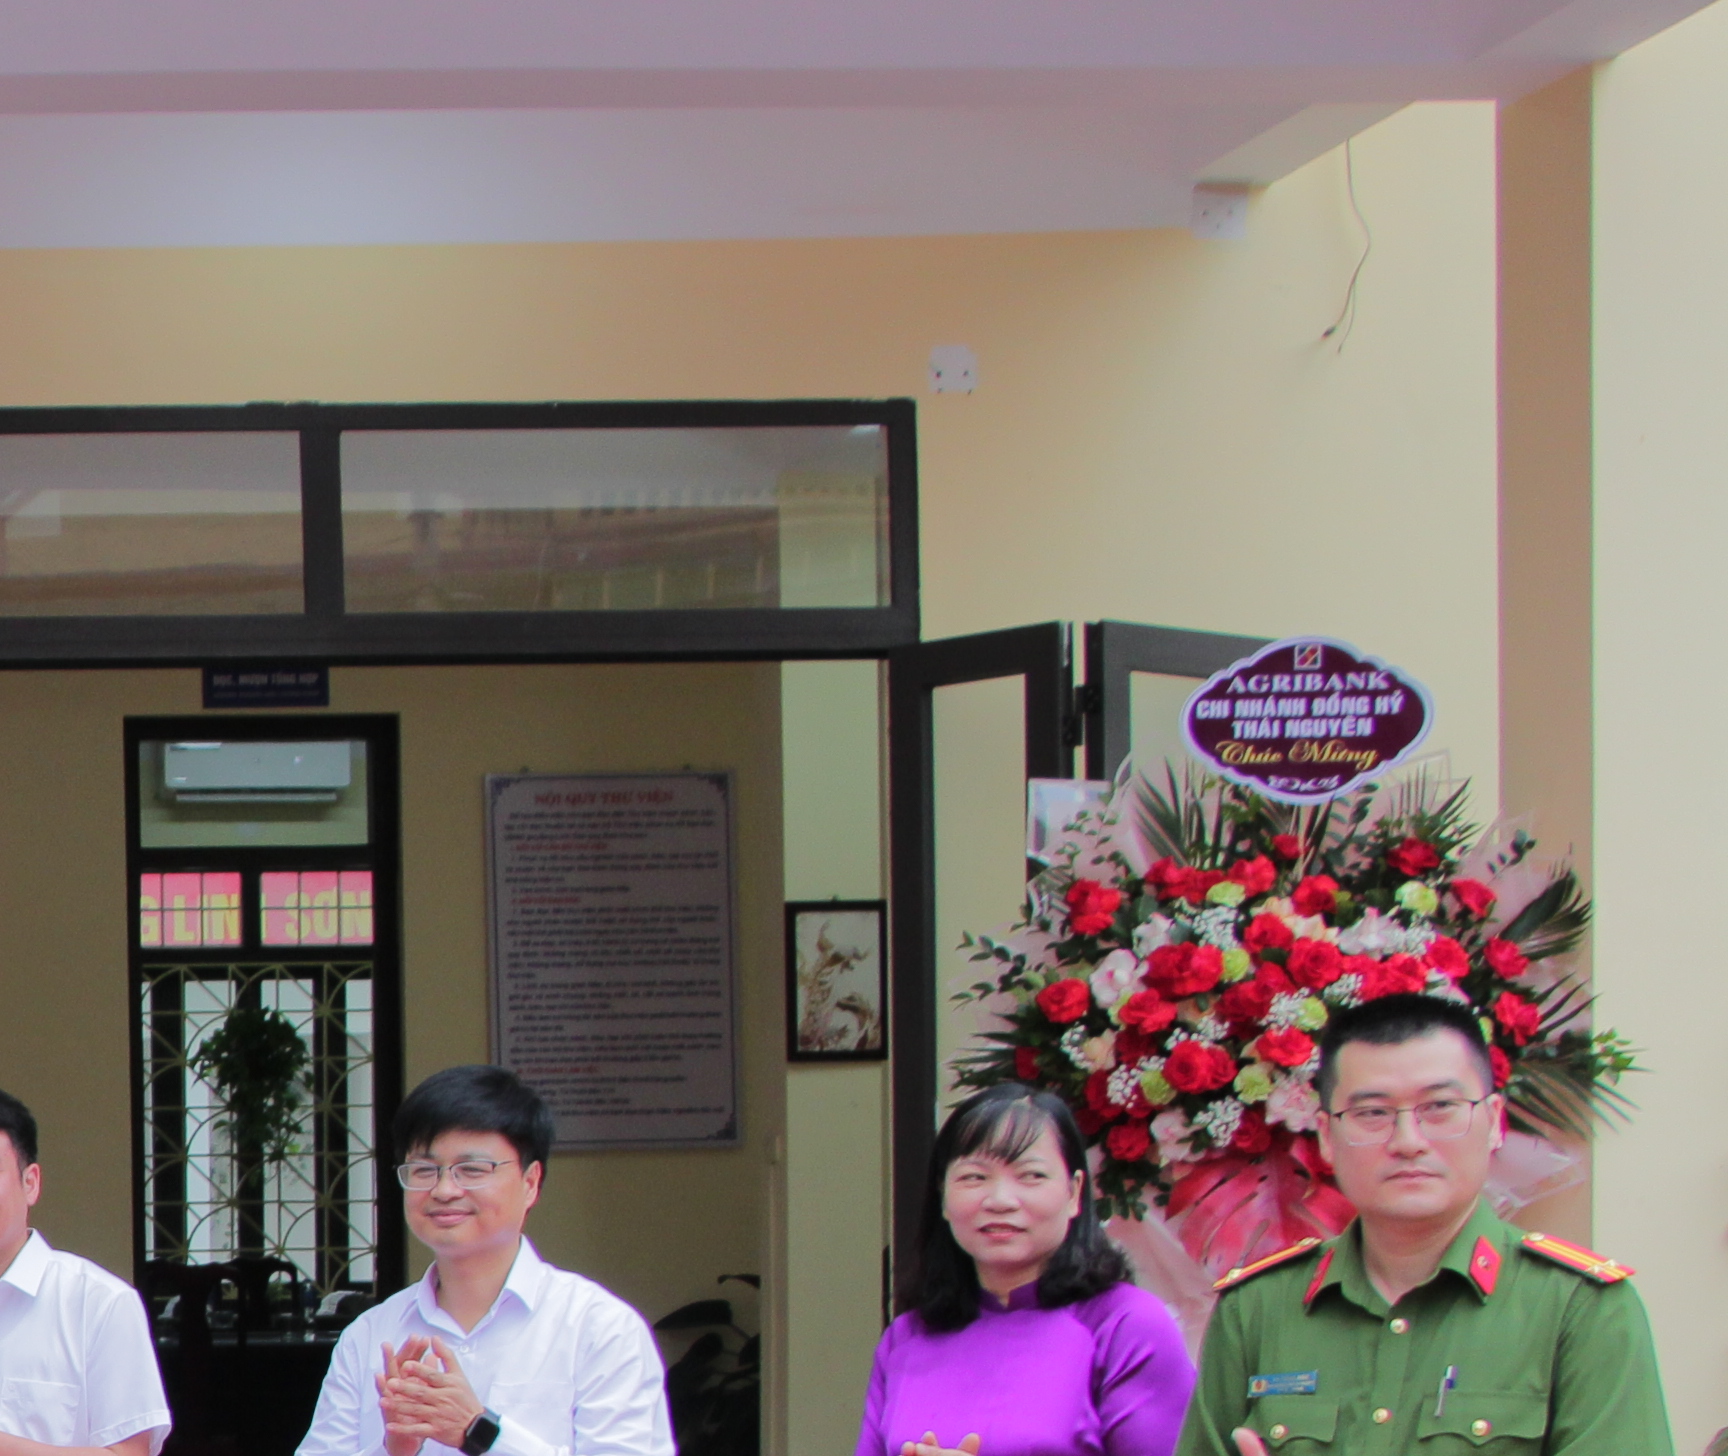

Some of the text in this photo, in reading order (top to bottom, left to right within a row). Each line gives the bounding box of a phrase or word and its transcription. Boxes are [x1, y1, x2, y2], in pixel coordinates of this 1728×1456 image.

[1226, 671, 1391, 694] AGRIBANK
[1196, 698, 1229, 719] CHI
[1234, 695, 1308, 718] NHÁNH
[1232, 715, 1374, 739] THÁI NGUYÊN
[1215, 738, 1380, 771] Chúc Mừng
